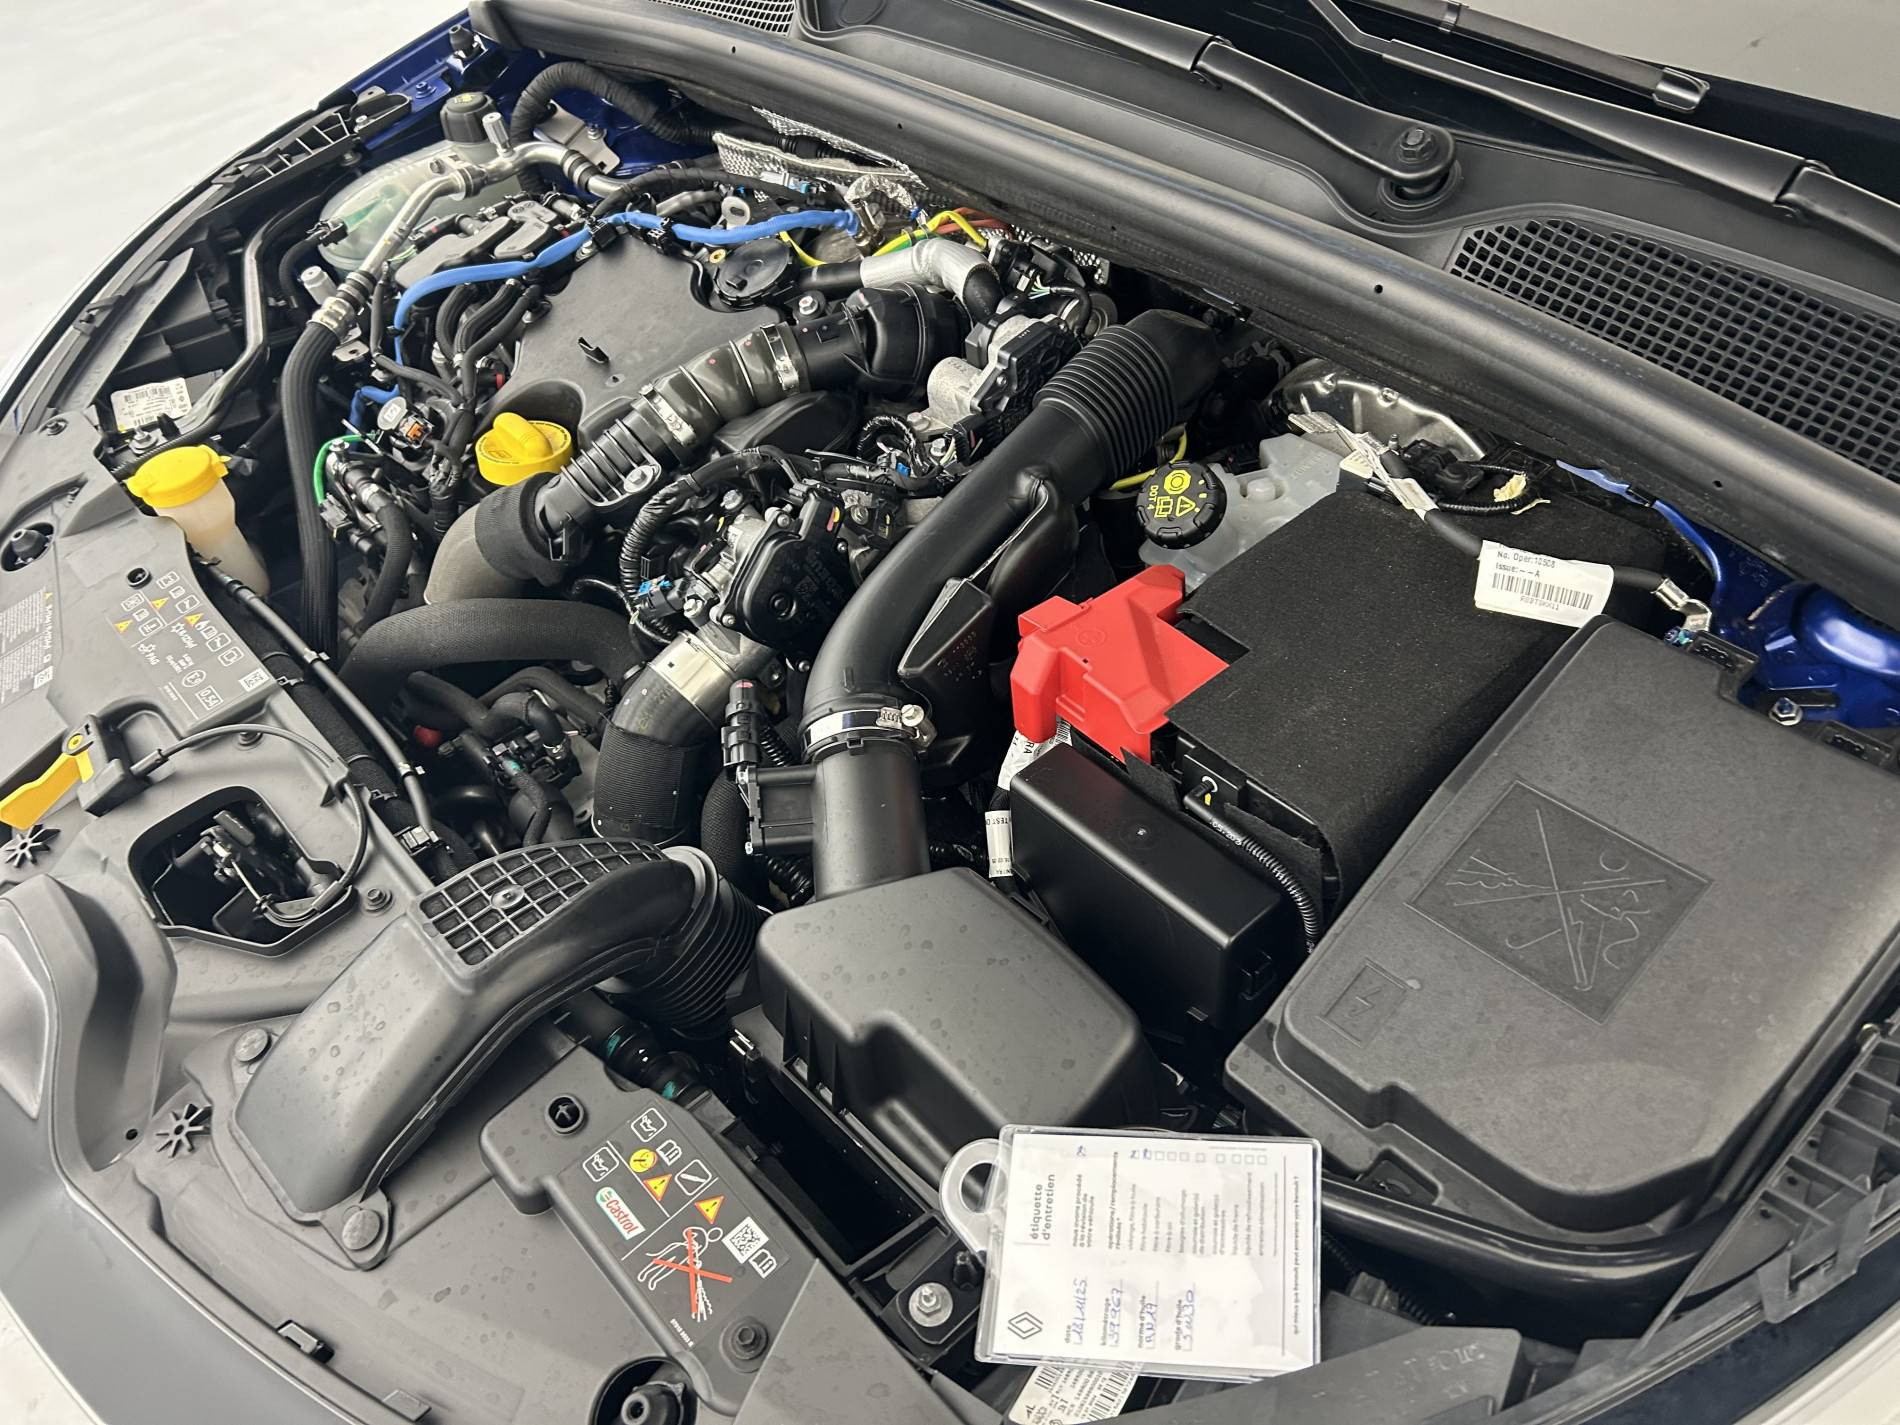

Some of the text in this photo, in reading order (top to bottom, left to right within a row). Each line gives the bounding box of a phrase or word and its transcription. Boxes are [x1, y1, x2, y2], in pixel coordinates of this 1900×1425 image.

[1148, 485, 1159, 502] DOT
[200, 689, 219, 707] 0,54
[606, 1199, 639, 1234] Castrol
[1030, 1184, 1043, 1240] étiquette
[1041, 1174, 1055, 1240] d'entretien
